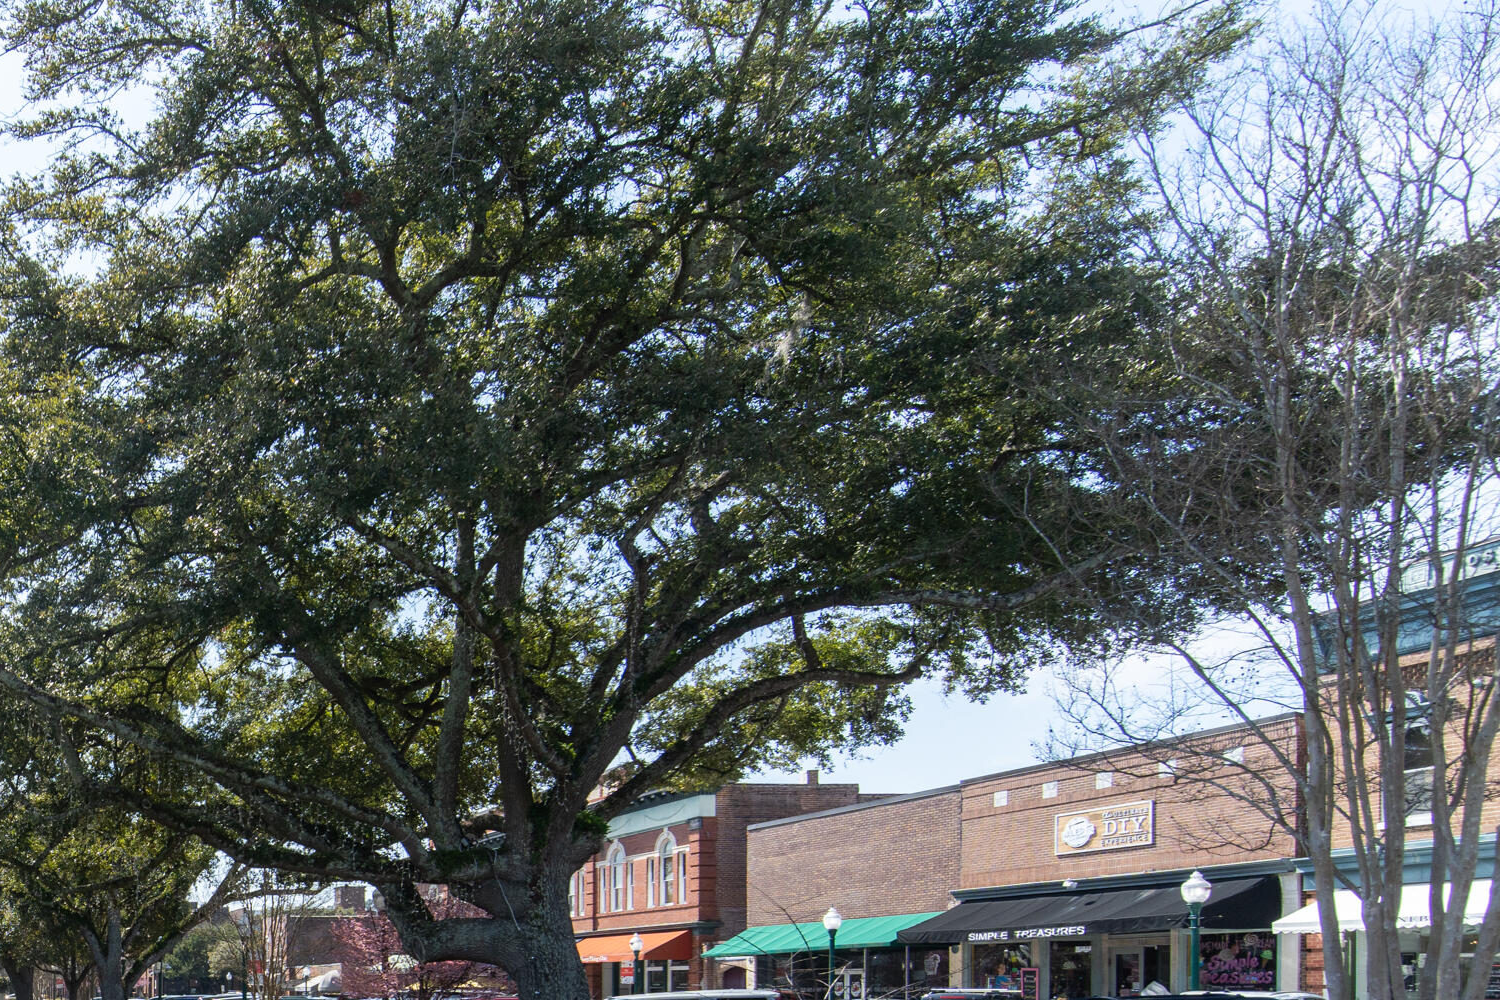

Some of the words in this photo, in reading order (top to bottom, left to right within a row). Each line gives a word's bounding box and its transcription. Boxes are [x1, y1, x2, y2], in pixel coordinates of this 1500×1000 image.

[1102, 816, 1147, 836] DIY
[968, 931, 1008, 941] SIMPLE
[1014, 926, 1085, 938] TREASURES
